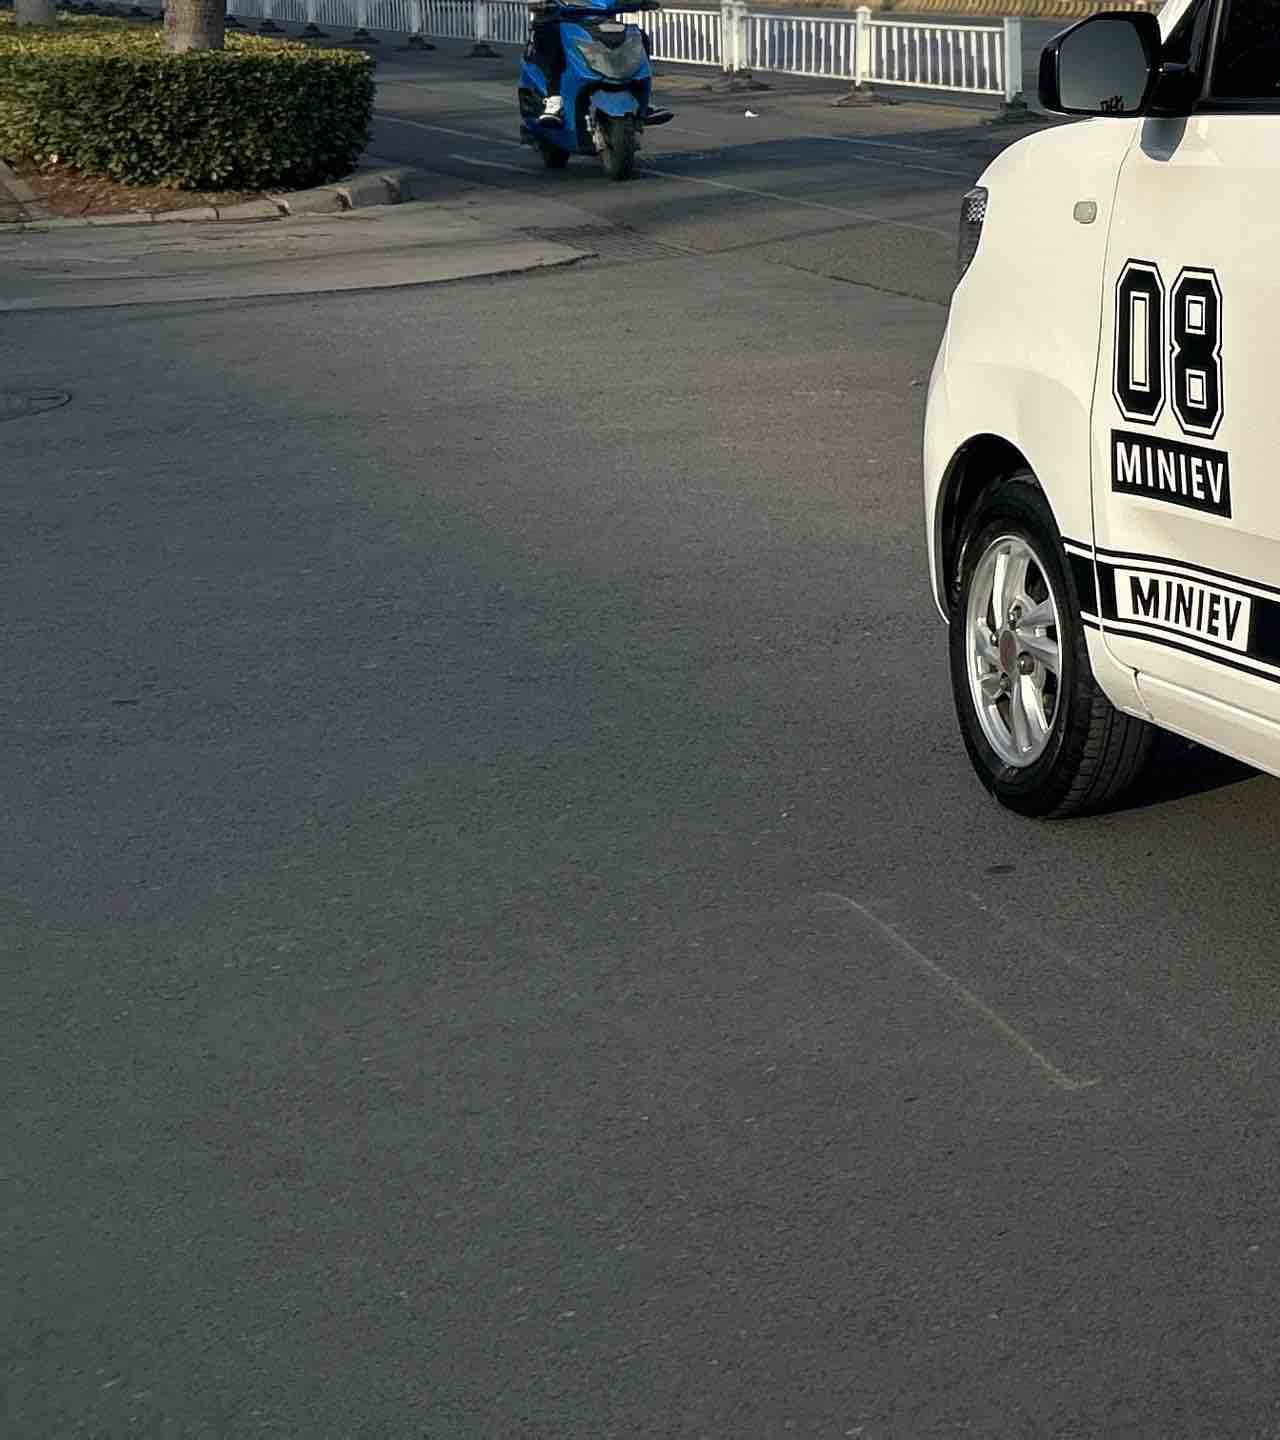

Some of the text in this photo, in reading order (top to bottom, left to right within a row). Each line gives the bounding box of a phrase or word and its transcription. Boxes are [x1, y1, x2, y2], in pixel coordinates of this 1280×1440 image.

[1112, 258, 1224, 439] 08
[1115, 441, 1224, 504] MINIEV
[1129, 576, 1242, 641] MINIEV
